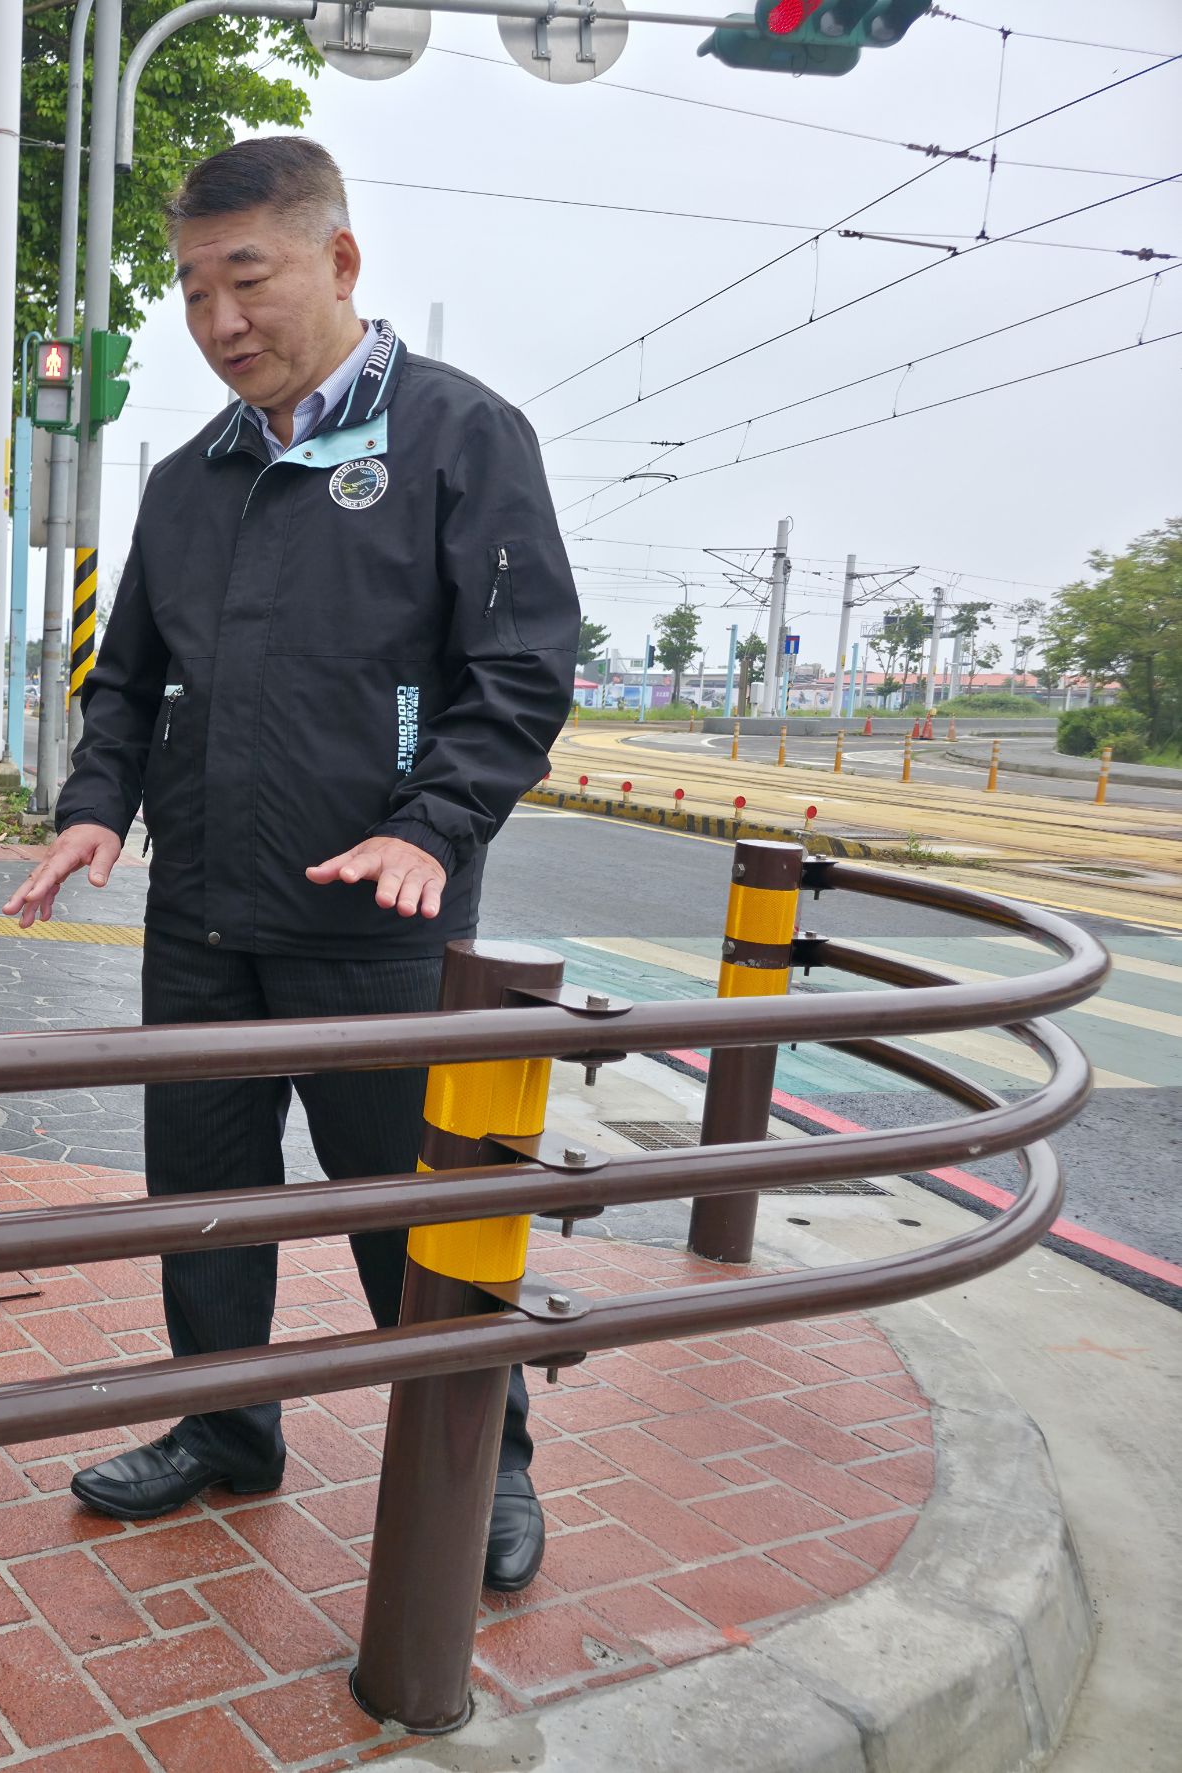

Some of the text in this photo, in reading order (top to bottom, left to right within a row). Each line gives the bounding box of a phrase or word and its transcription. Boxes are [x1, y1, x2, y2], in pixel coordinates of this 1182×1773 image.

[332, 460, 386, 491] THE UNITED KINGDOM
[339, 498, 358, 508] SINCE
[397, 686, 407, 770] CROCODILE
